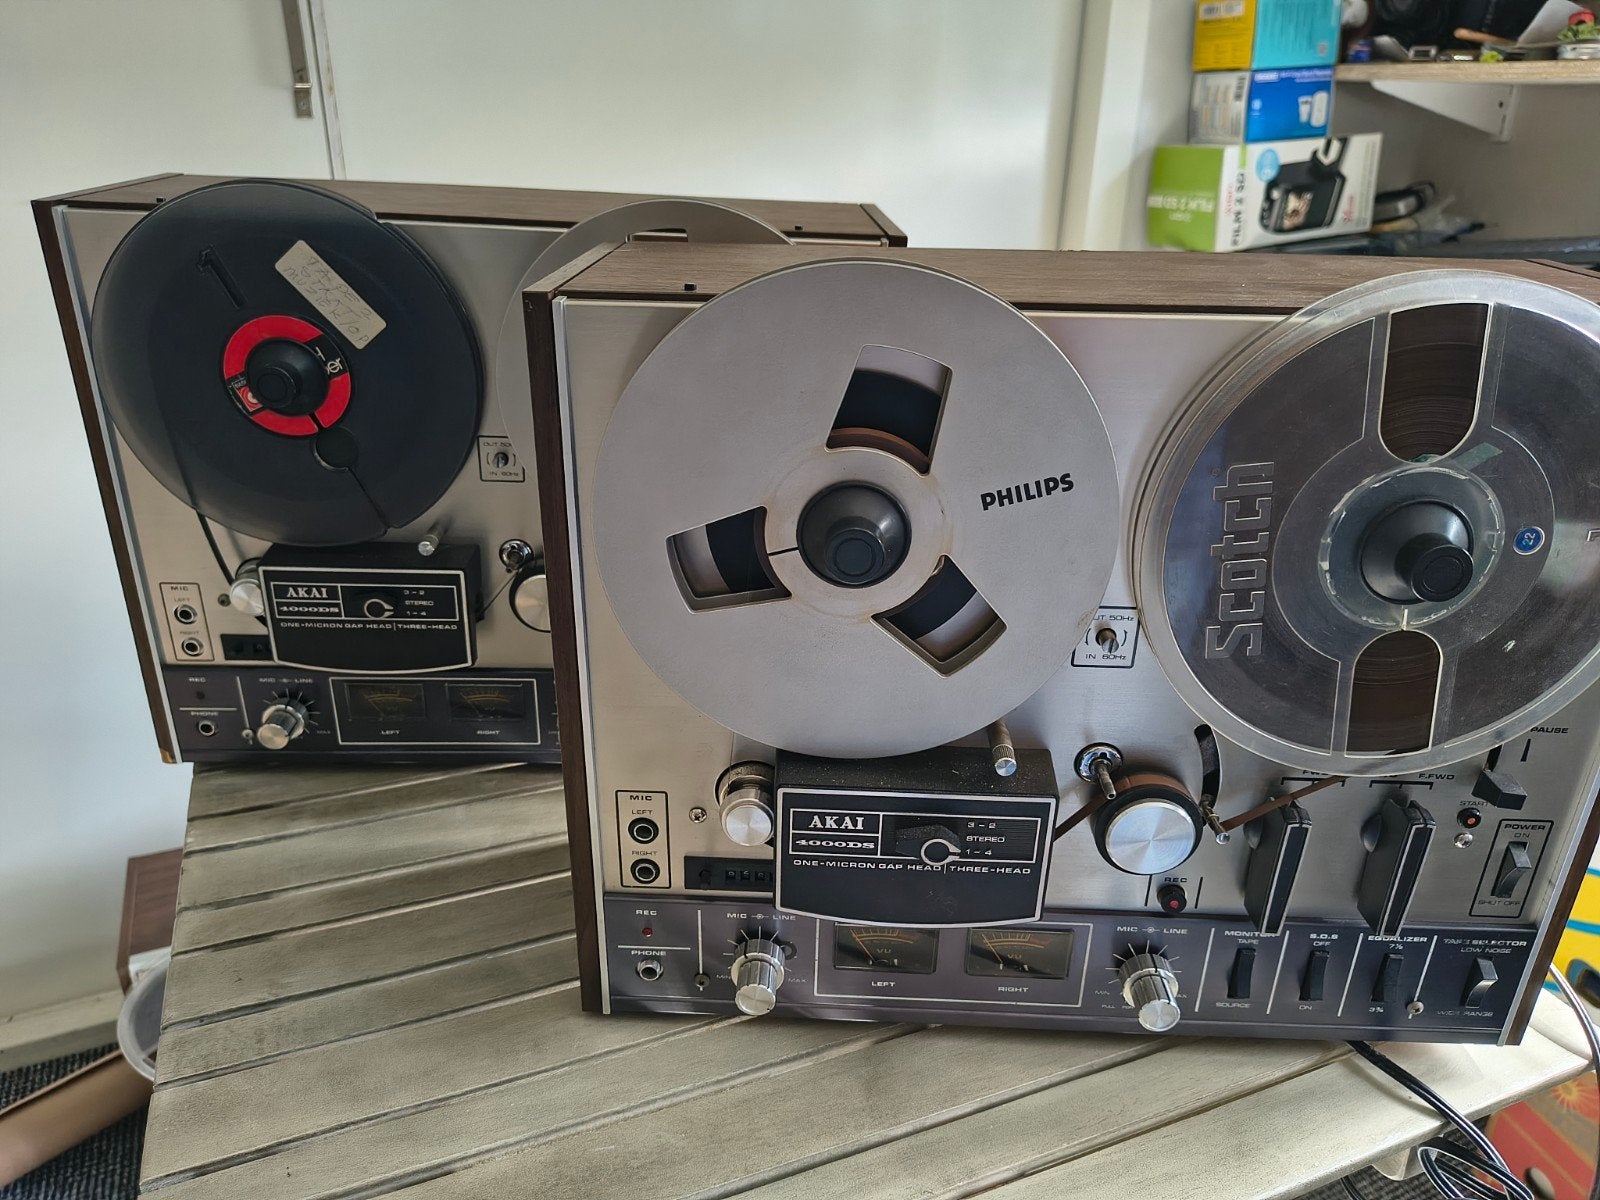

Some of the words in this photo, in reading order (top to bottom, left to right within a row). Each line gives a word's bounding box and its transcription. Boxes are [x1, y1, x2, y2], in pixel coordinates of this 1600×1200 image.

[980, 473, 1075, 511] PHILIPS
[1522, 531, 1536, 546] 22
[1204, 461, 1275, 660] Scotch
[286, 586, 329, 599] AKAI
[279, 605, 340, 613] 4000DS
[1101, 653, 1127, 661] 60Hz
[1530, 726, 1569, 734] PAUSE
[1418, 773, 1456, 781] F.FWD
[808, 815, 865, 830] AKAI
[1504, 823, 1546, 831] POWER
[966, 835, 1005, 843] STEREO
[795, 839, 875, 849] 4000DS
[793, 859, 876, 869] ONE-MICRON
[907, 864, 942, 872] HEAD
[949, 865, 1031, 875] THREE-HEAD
[635, 909, 658, 917] REC
